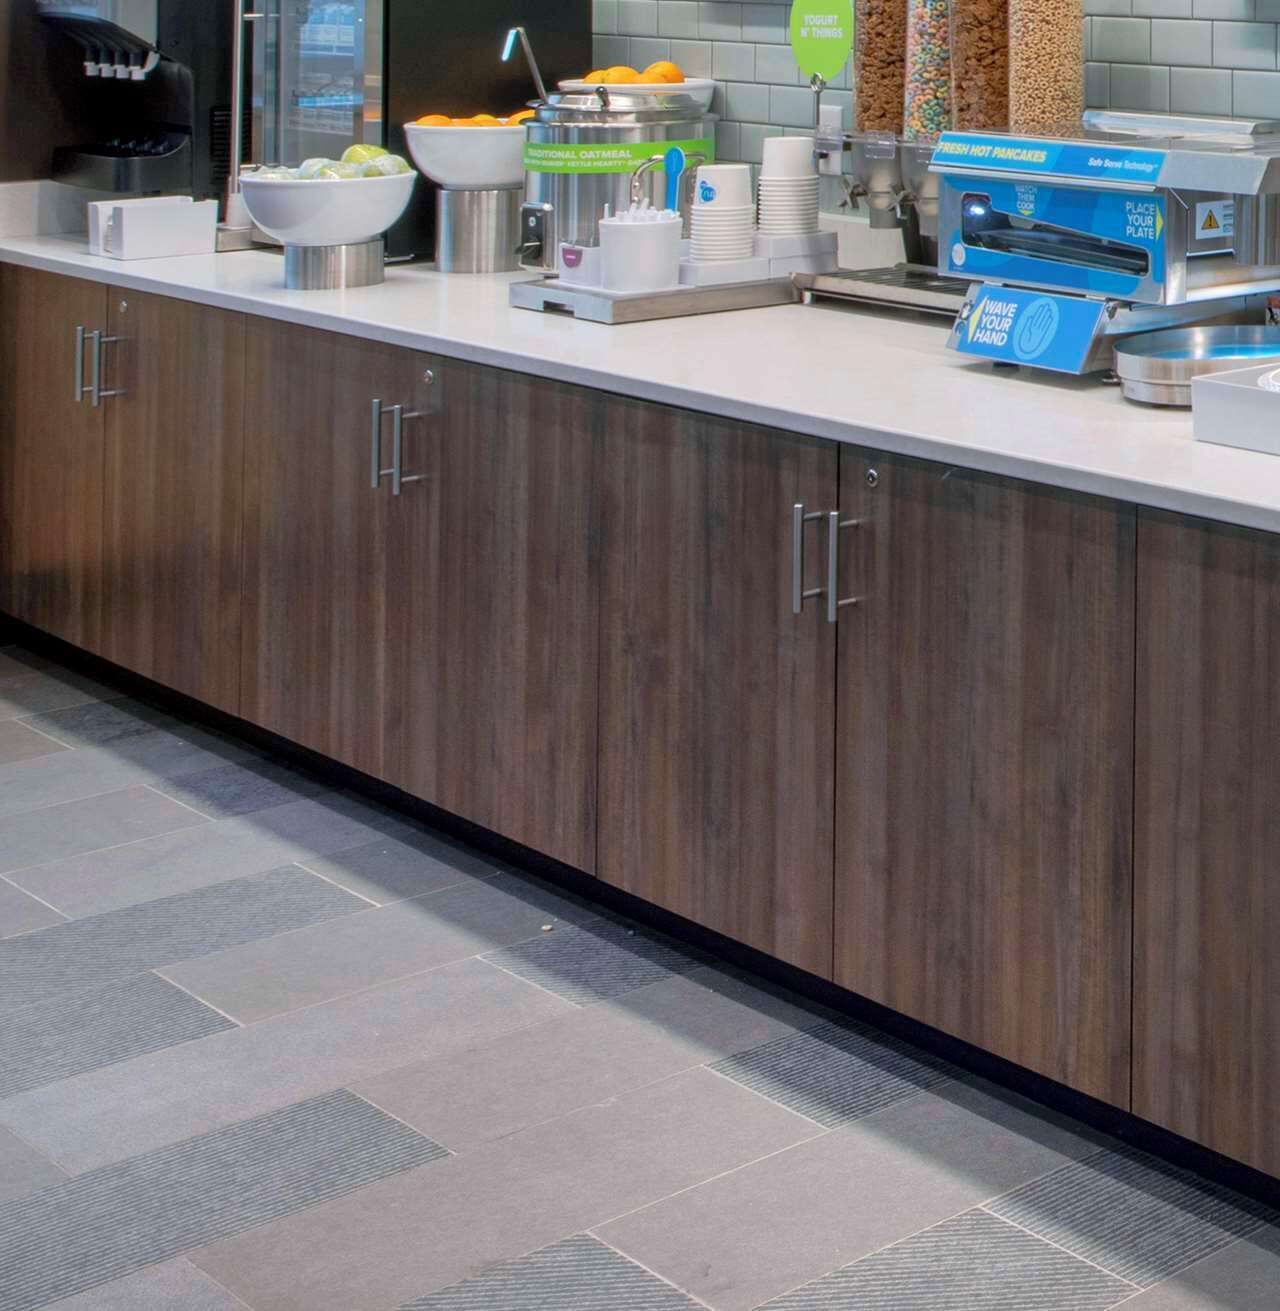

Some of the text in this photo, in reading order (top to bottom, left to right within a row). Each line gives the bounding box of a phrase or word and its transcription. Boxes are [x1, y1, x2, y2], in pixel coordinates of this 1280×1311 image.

[804, 15, 838, 26] YOGURT
[812, 27, 843, 39] THINGS
[579, 150, 633, 159] OATMEAL
[937, 142, 1048, 163] FRESH HOT PANCAKES
[1017, 193, 1035, 201] THEM
[1016, 201, 1034, 209] COOK
[1126, 201, 1155, 215] PLACE
[1128, 214, 1153, 227] YOUR
[1126, 226, 1155, 239] PLATE
[984, 299, 1018, 317] WAVE
[981, 314, 1013, 332] YOUR
[973, 329, 1008, 346] HAND
